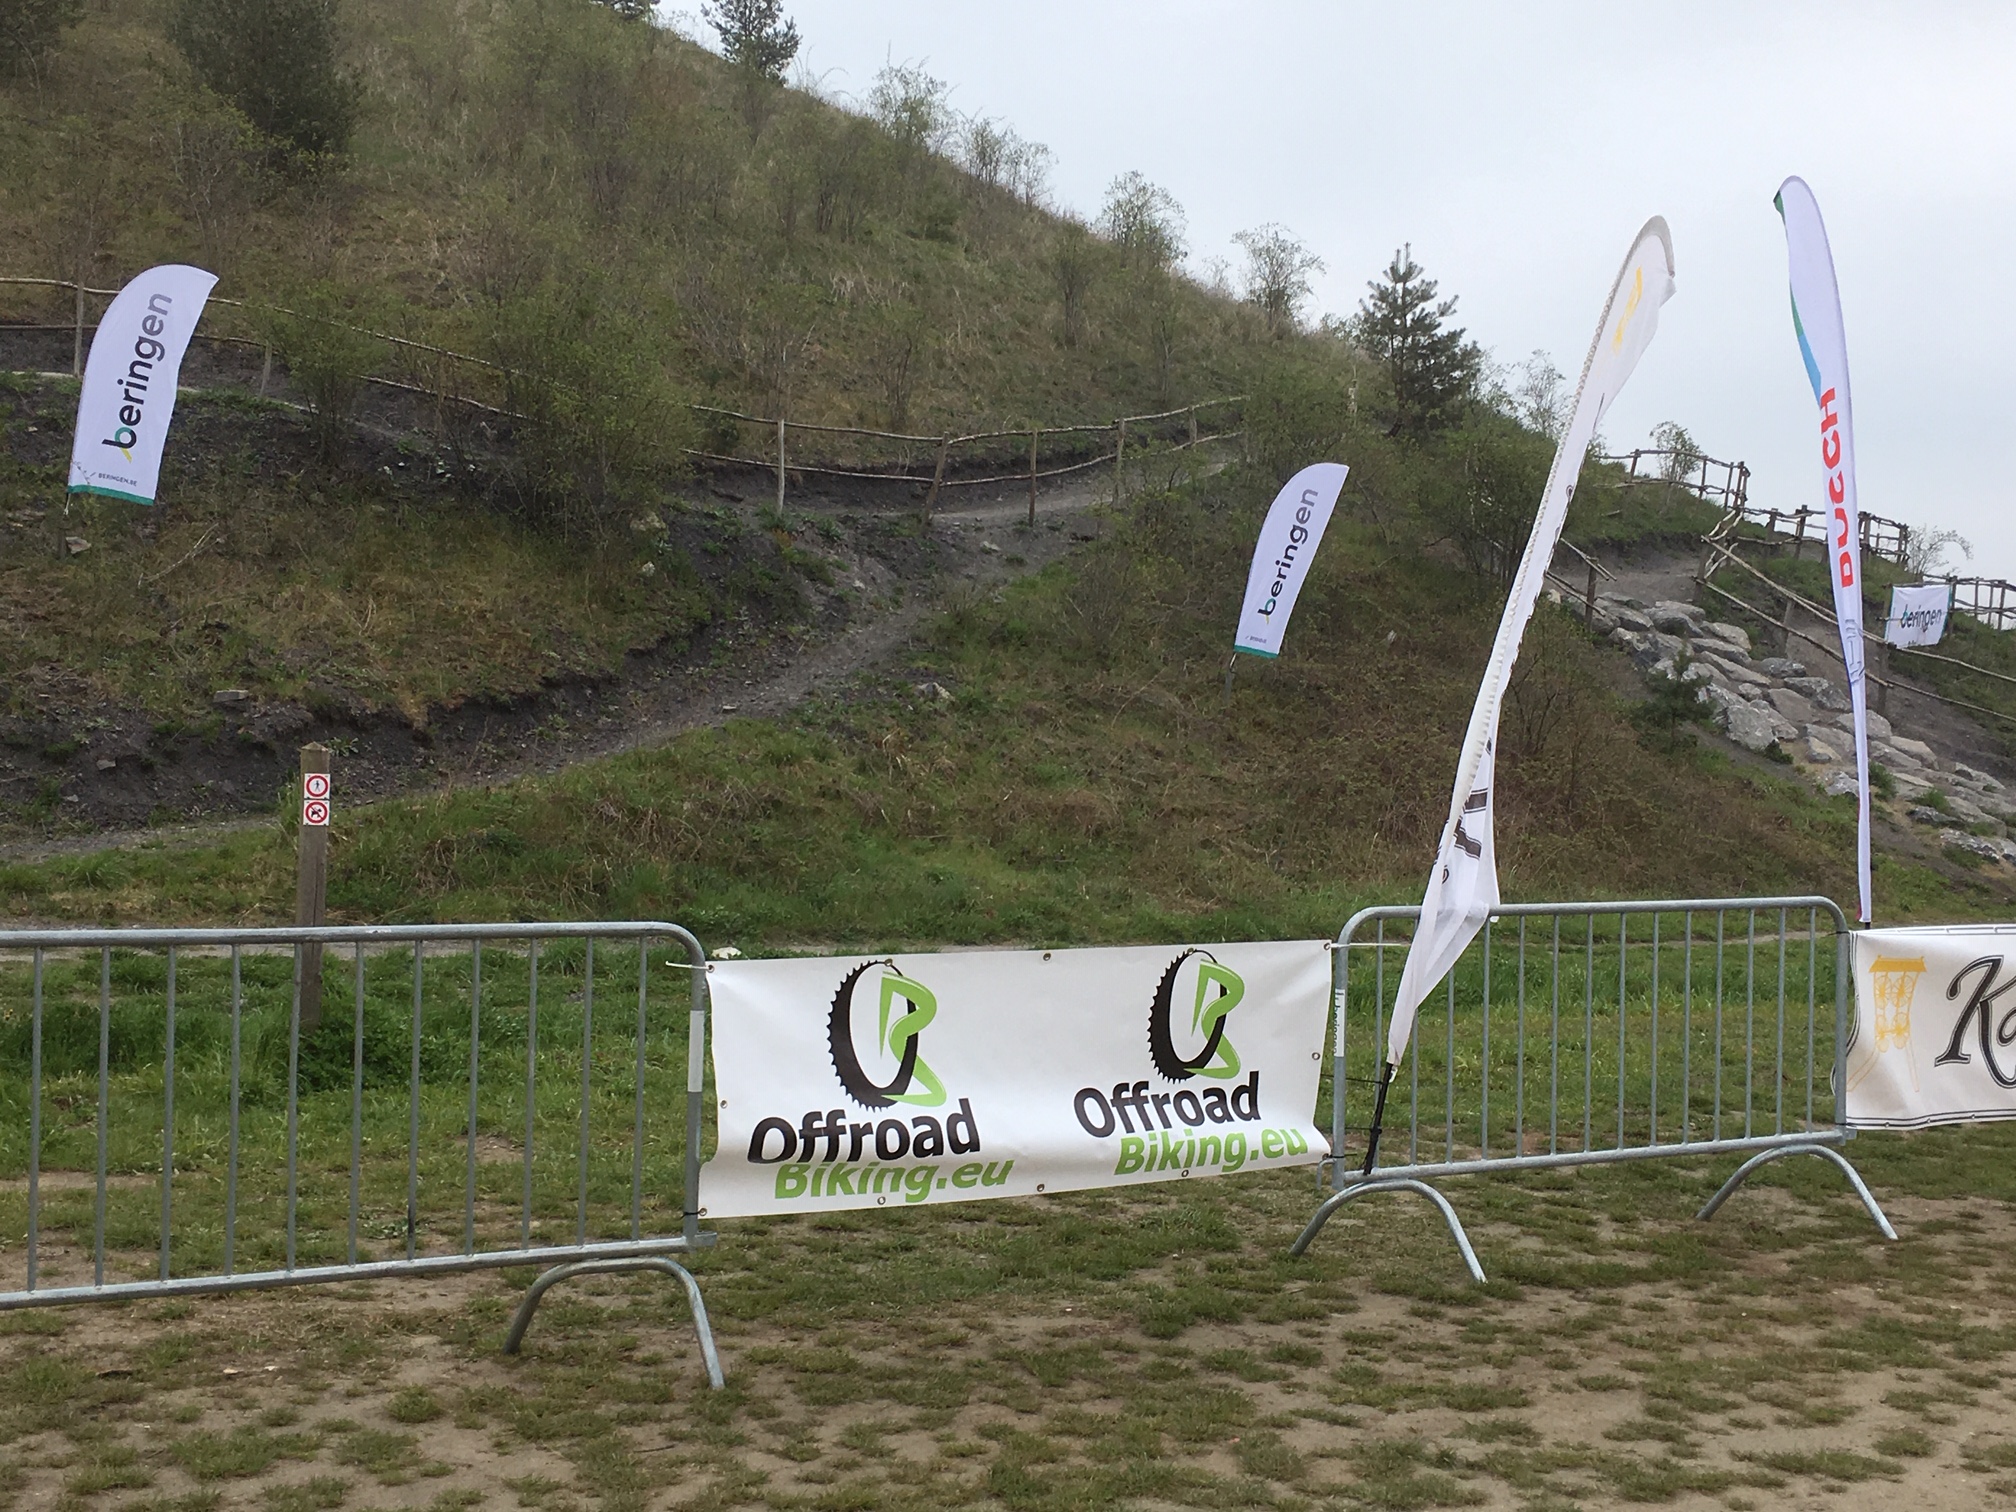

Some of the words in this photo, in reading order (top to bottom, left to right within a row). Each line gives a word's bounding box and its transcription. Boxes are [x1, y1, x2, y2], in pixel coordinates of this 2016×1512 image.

[102, 292, 172, 450] beringen
[1257, 488, 1319, 617] beringen
[1900, 603, 1942, 633] beringen
[747, 1097, 981, 1164] Offroad
[1073, 1070, 1262, 1138] Offroad
[774, 1159, 1015, 1204] Biking.eu
[1113, 1127, 1308, 1176] Biking.eu
